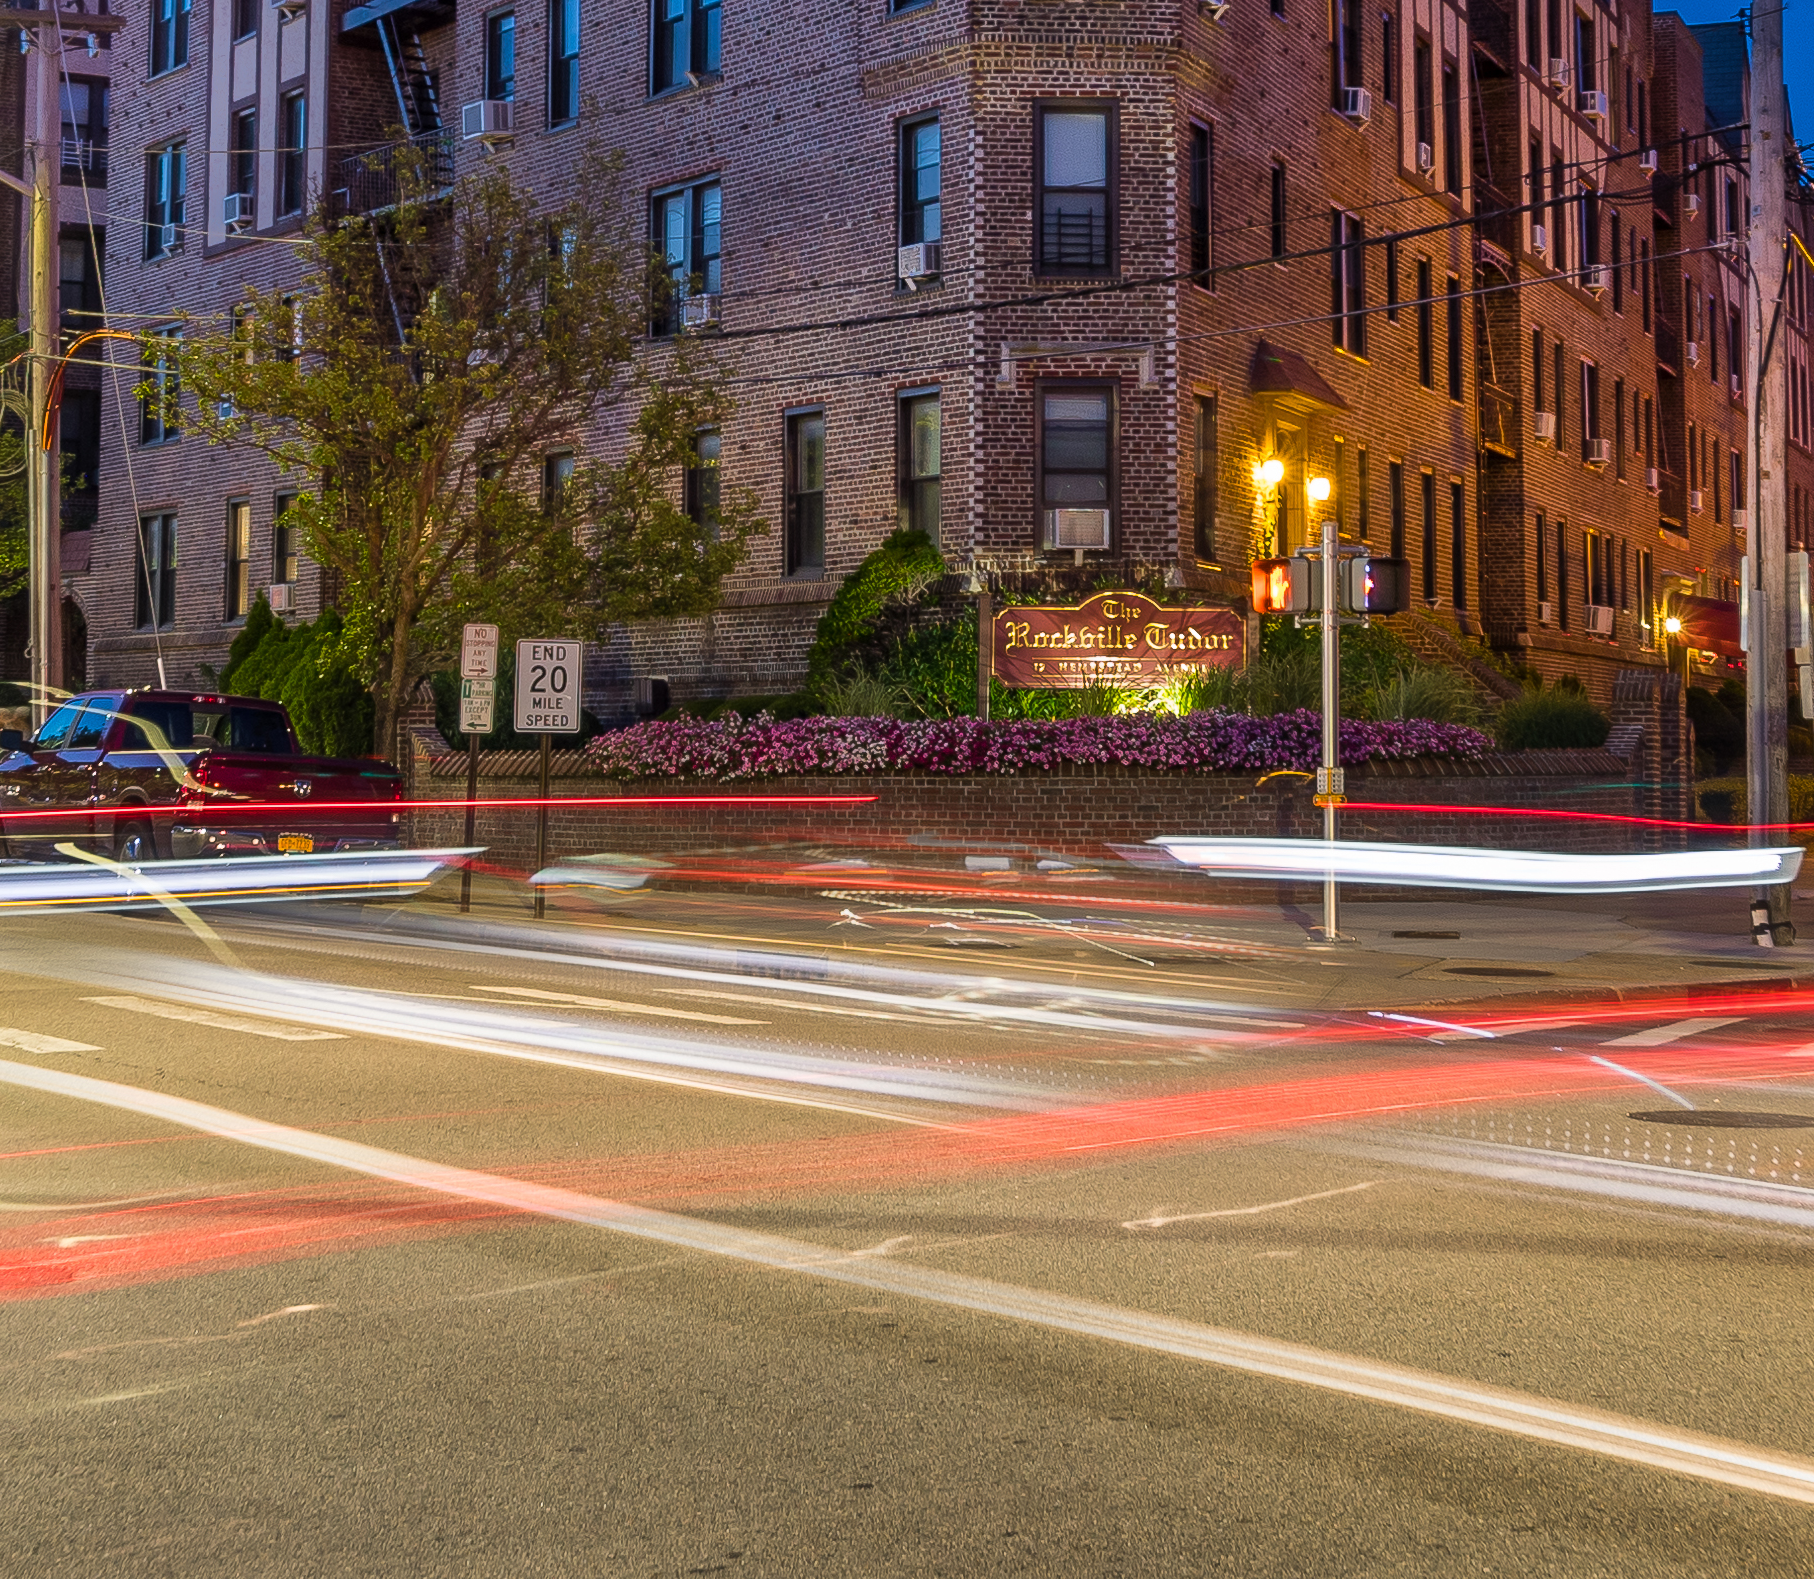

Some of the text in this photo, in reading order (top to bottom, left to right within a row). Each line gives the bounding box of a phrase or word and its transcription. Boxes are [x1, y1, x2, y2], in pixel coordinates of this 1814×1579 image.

[1101, 600, 1141, 623] The
[474, 629, 487, 638] NO
[1005, 622, 1233, 656] Rockville Tudor
[532, 645, 567, 662] END
[472, 659, 487, 667] TIME
[530, 665, 567, 693] 20
[471, 689, 492, 697] PARKING
[532, 697, 563, 709] MILE
[526, 714, 569, 727] SPEED
